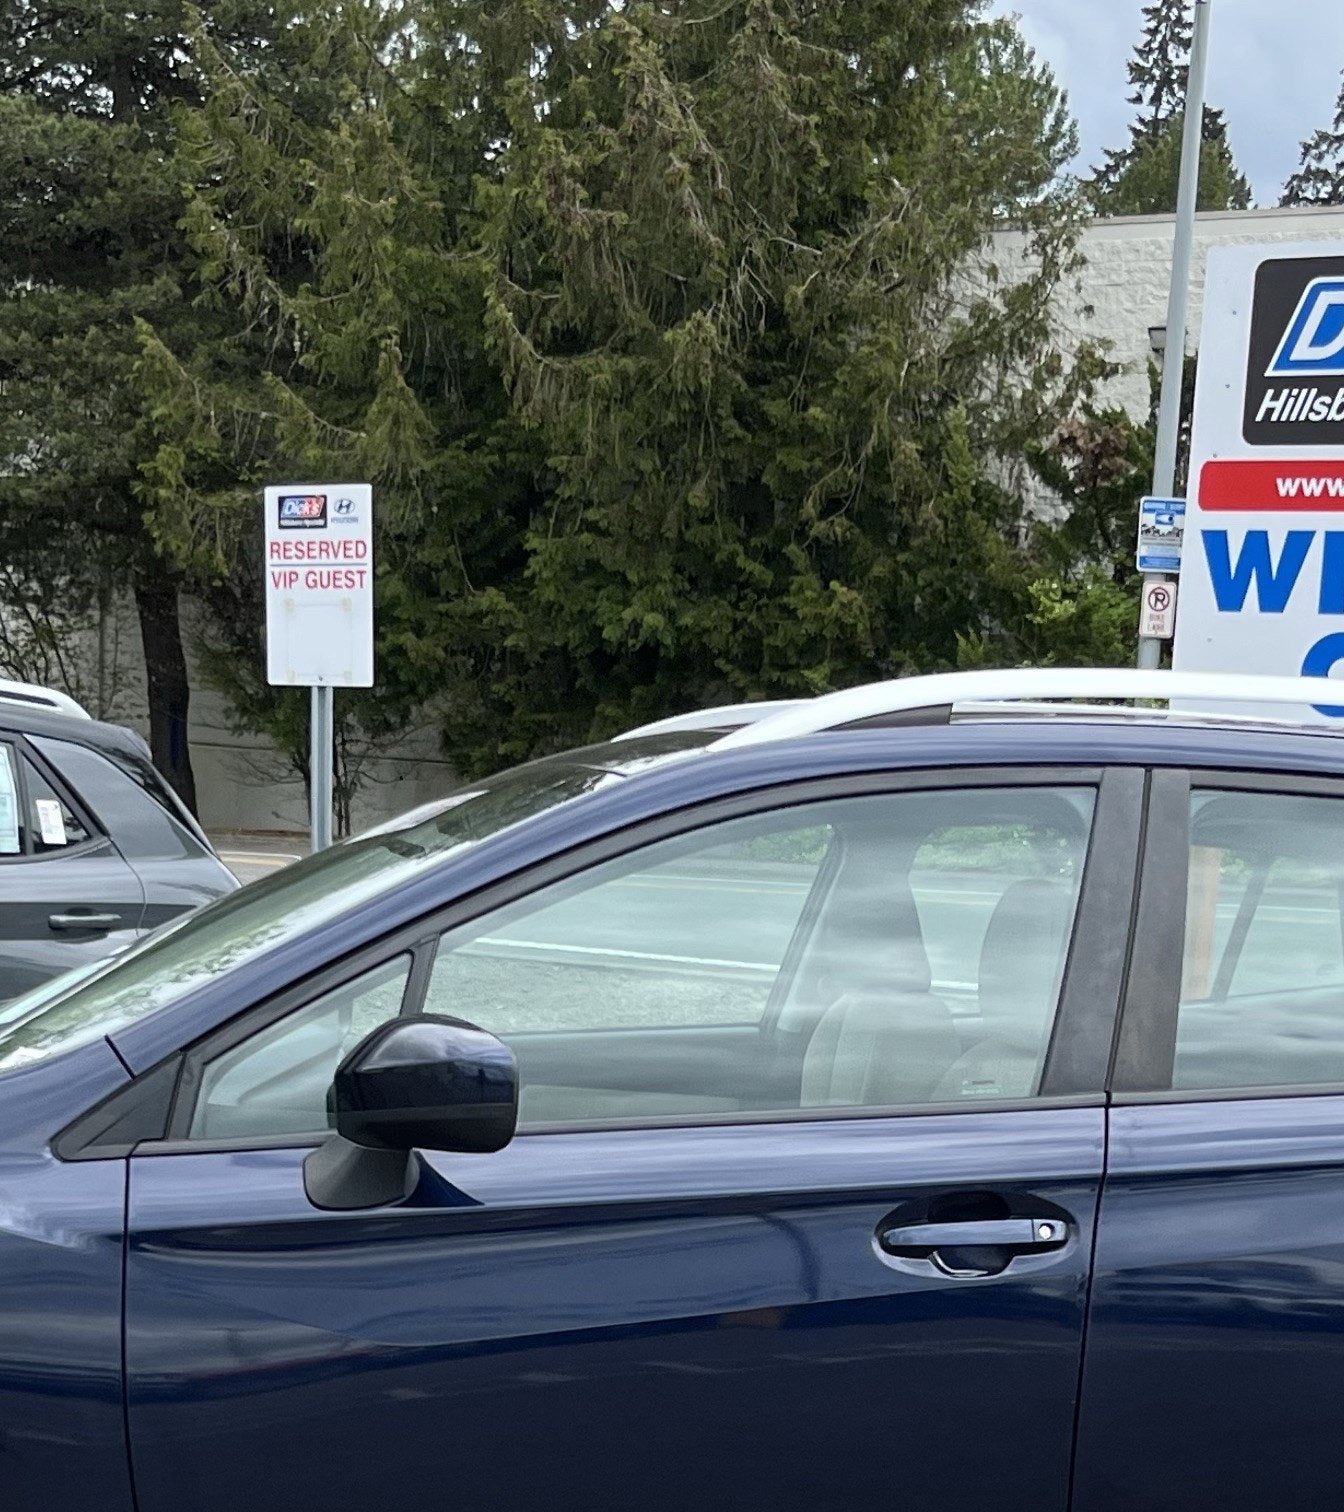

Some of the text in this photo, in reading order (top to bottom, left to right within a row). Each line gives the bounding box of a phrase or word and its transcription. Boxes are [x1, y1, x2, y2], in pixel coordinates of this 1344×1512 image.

[269, 540, 367, 560] RESERVED
[271, 570, 366, 589] VIP GUEST
